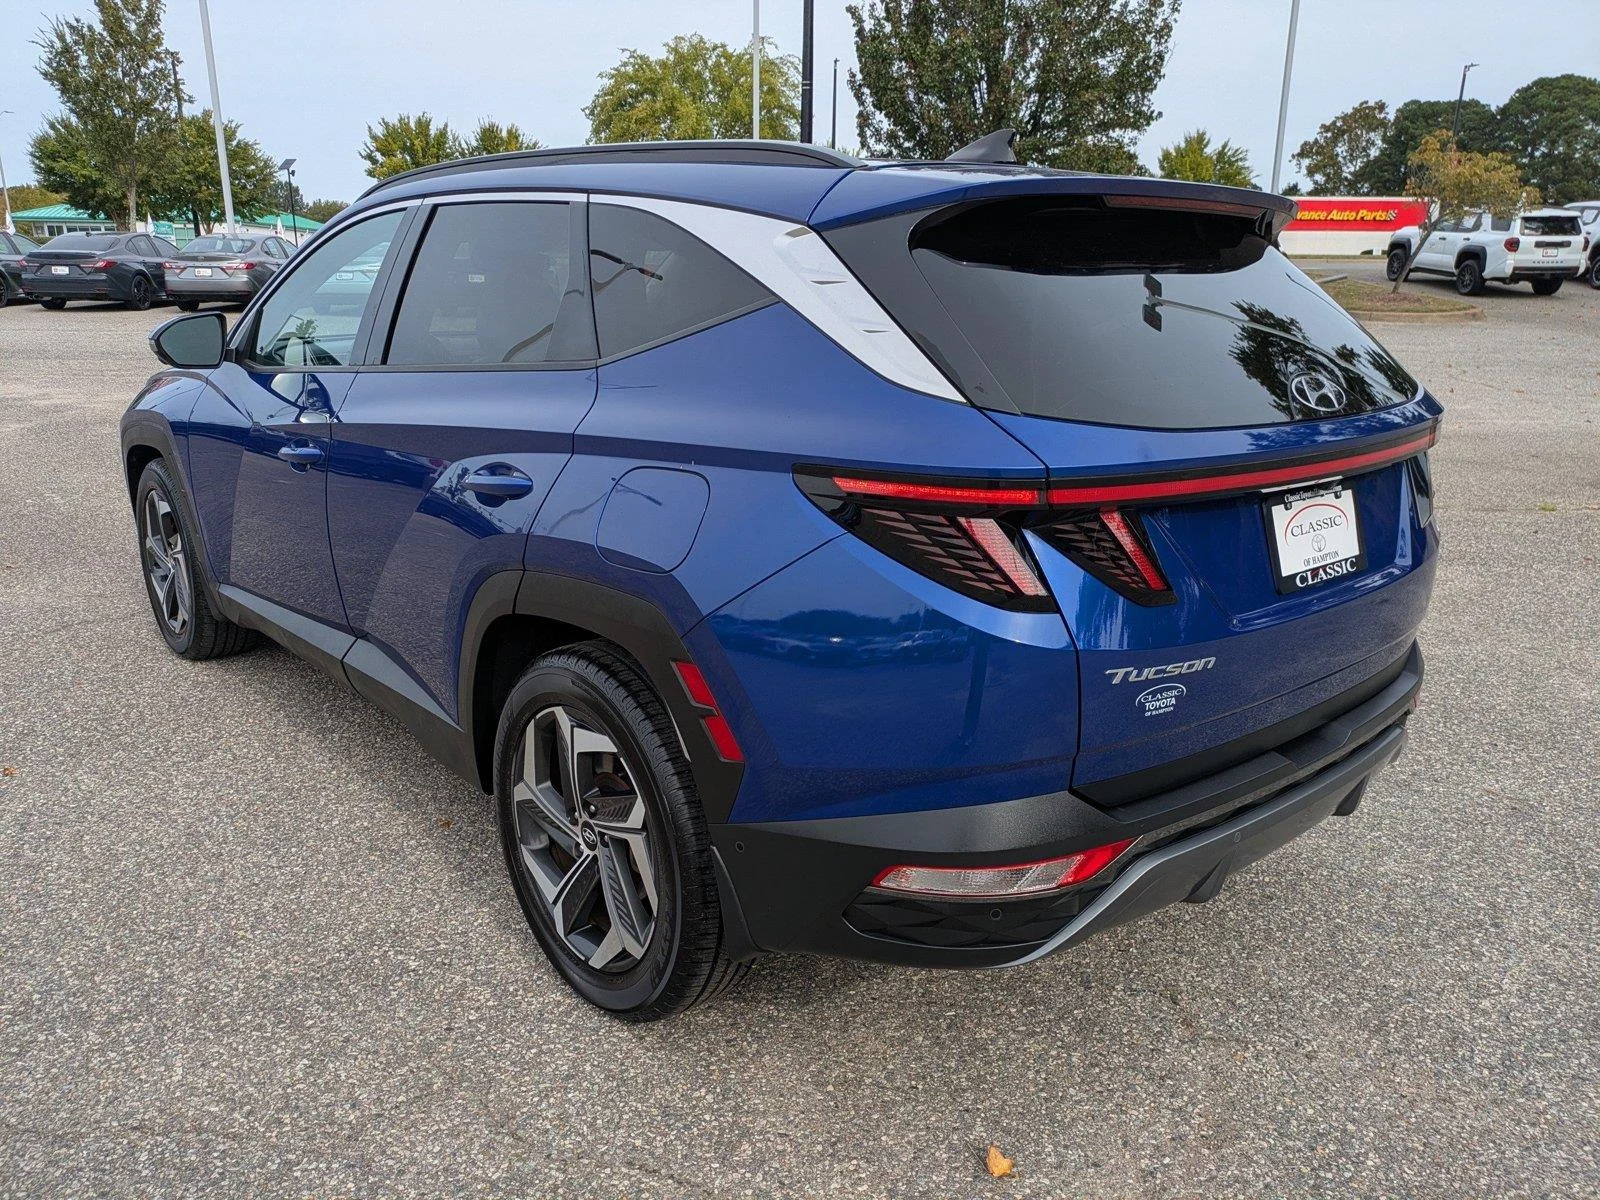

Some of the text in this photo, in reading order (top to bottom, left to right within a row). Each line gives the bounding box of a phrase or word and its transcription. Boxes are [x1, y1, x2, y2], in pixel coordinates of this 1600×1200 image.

[1296, 209, 1387, 221] vance Auto Parts
[1290, 515, 1342, 537] CLASSIC
[1303, 550, 1340, 567] OF HAMPTON
[1296, 558, 1357, 587] CLASSIC
[1141, 688, 1182, 703] CLASSIC
[1145, 697, 1176, 711] TOYOTA
